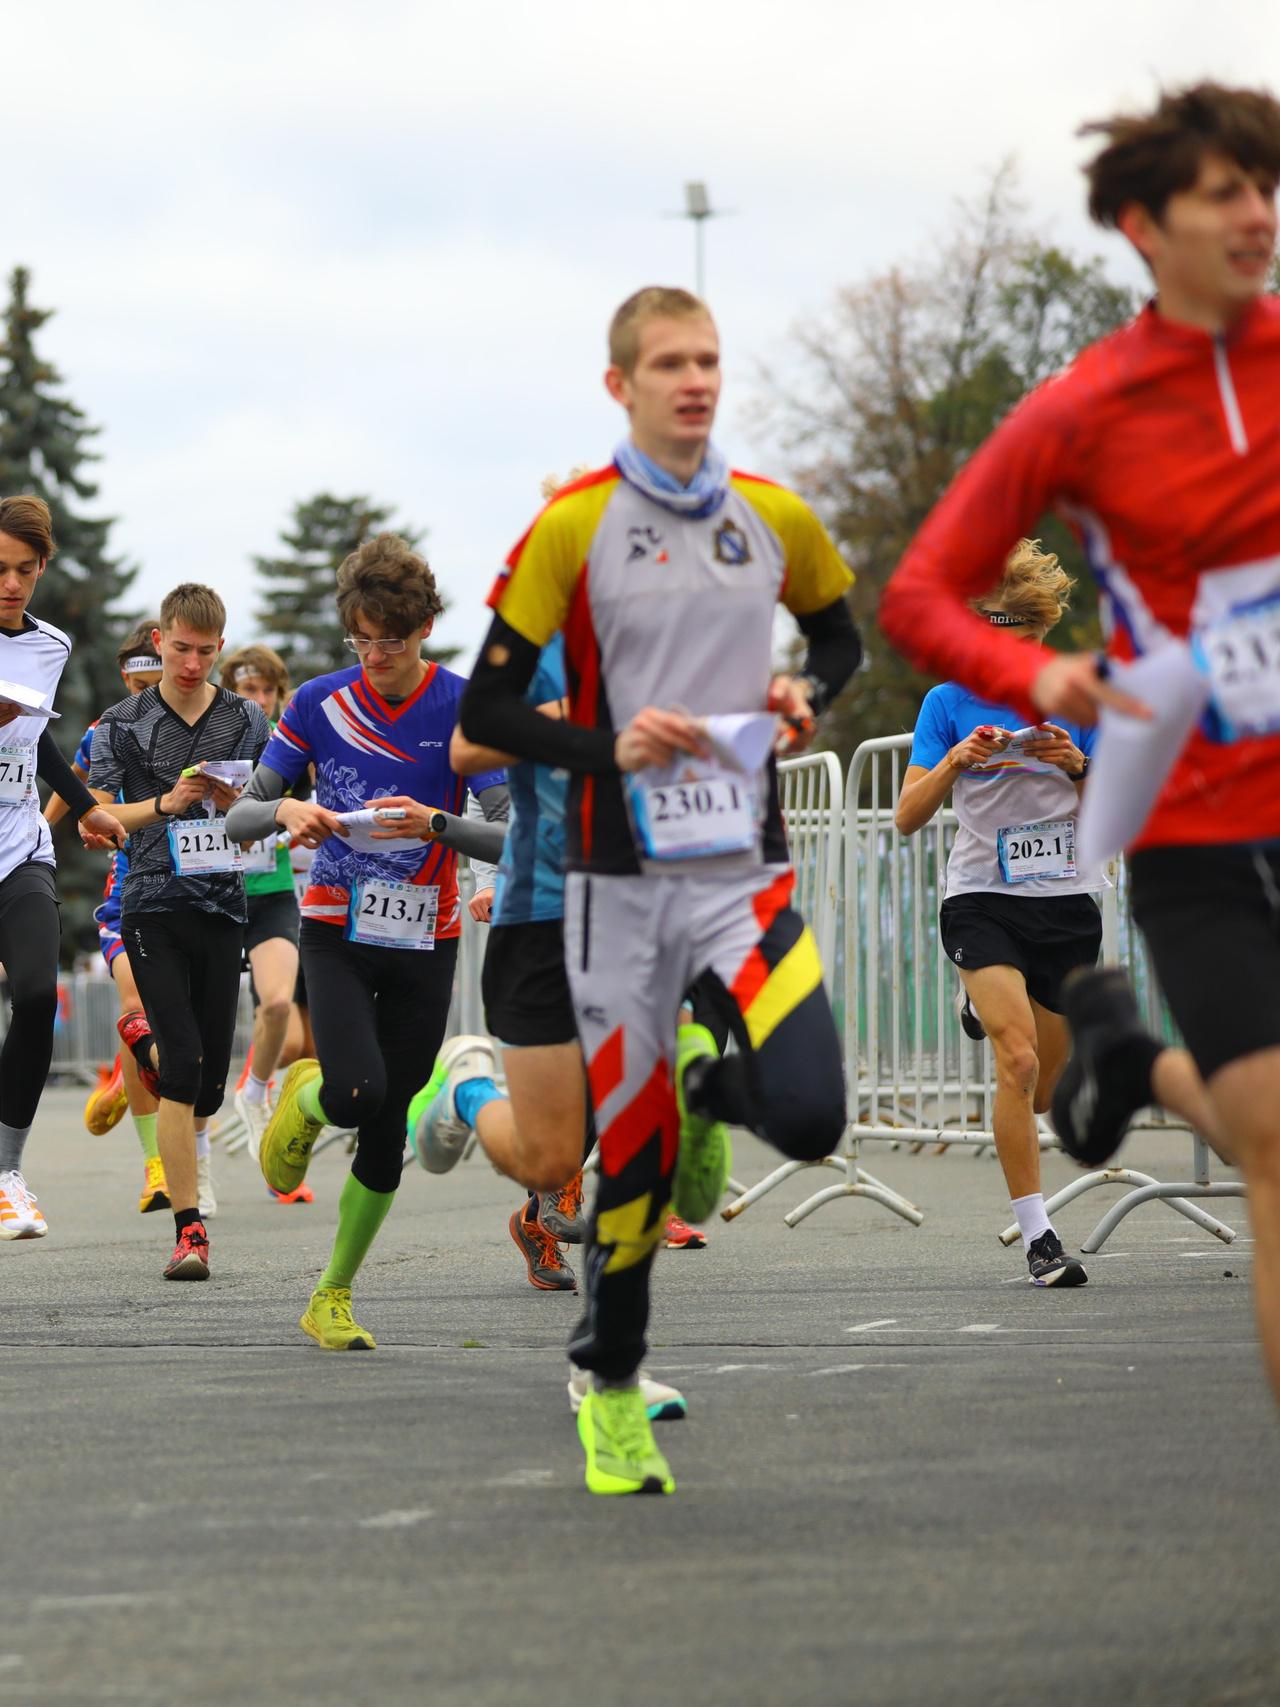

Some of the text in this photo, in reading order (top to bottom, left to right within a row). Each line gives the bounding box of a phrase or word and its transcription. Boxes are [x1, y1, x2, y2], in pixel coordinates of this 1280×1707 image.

[126, 660, 162, 669] nonam
[654, 782, 740, 821] 230.1
[180, 833, 230, 854] 212.1
[1009, 836, 1063, 860] 202.1
[361, 893, 426, 922] 213.1
